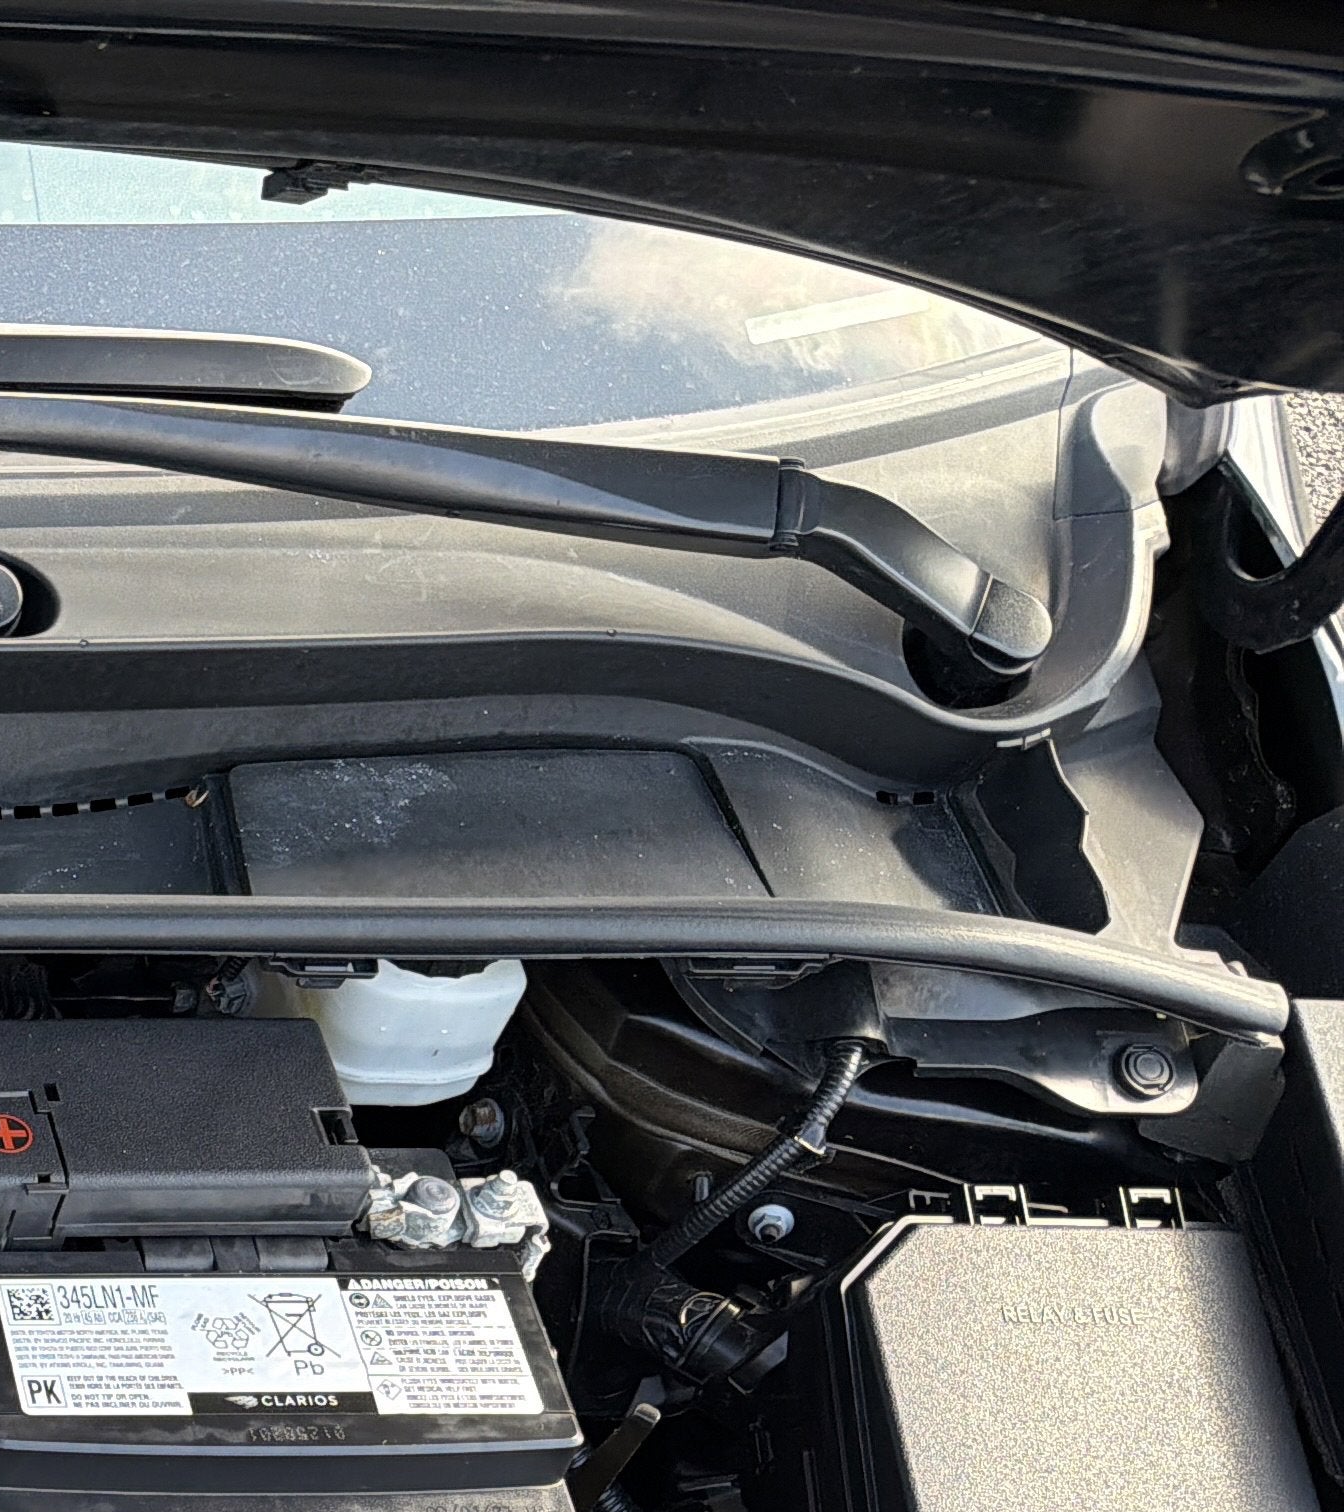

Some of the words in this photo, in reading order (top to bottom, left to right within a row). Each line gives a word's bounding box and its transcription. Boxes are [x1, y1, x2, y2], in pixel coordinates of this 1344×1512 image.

[361, 1279, 488, 1289] DANGER/POISON
[57, 1284, 159, 1309] 345LN1-MF
[1001, 1304, 1065, 1324] RELAY
[1073, 1307, 1089, 1324] &
[1092, 1307, 1146, 1325] FUSE
[294, 1359, 324, 1375] Pb
[27, 1379, 62, 1404] PK
[262, 1395, 339, 1407] CLARIOS
